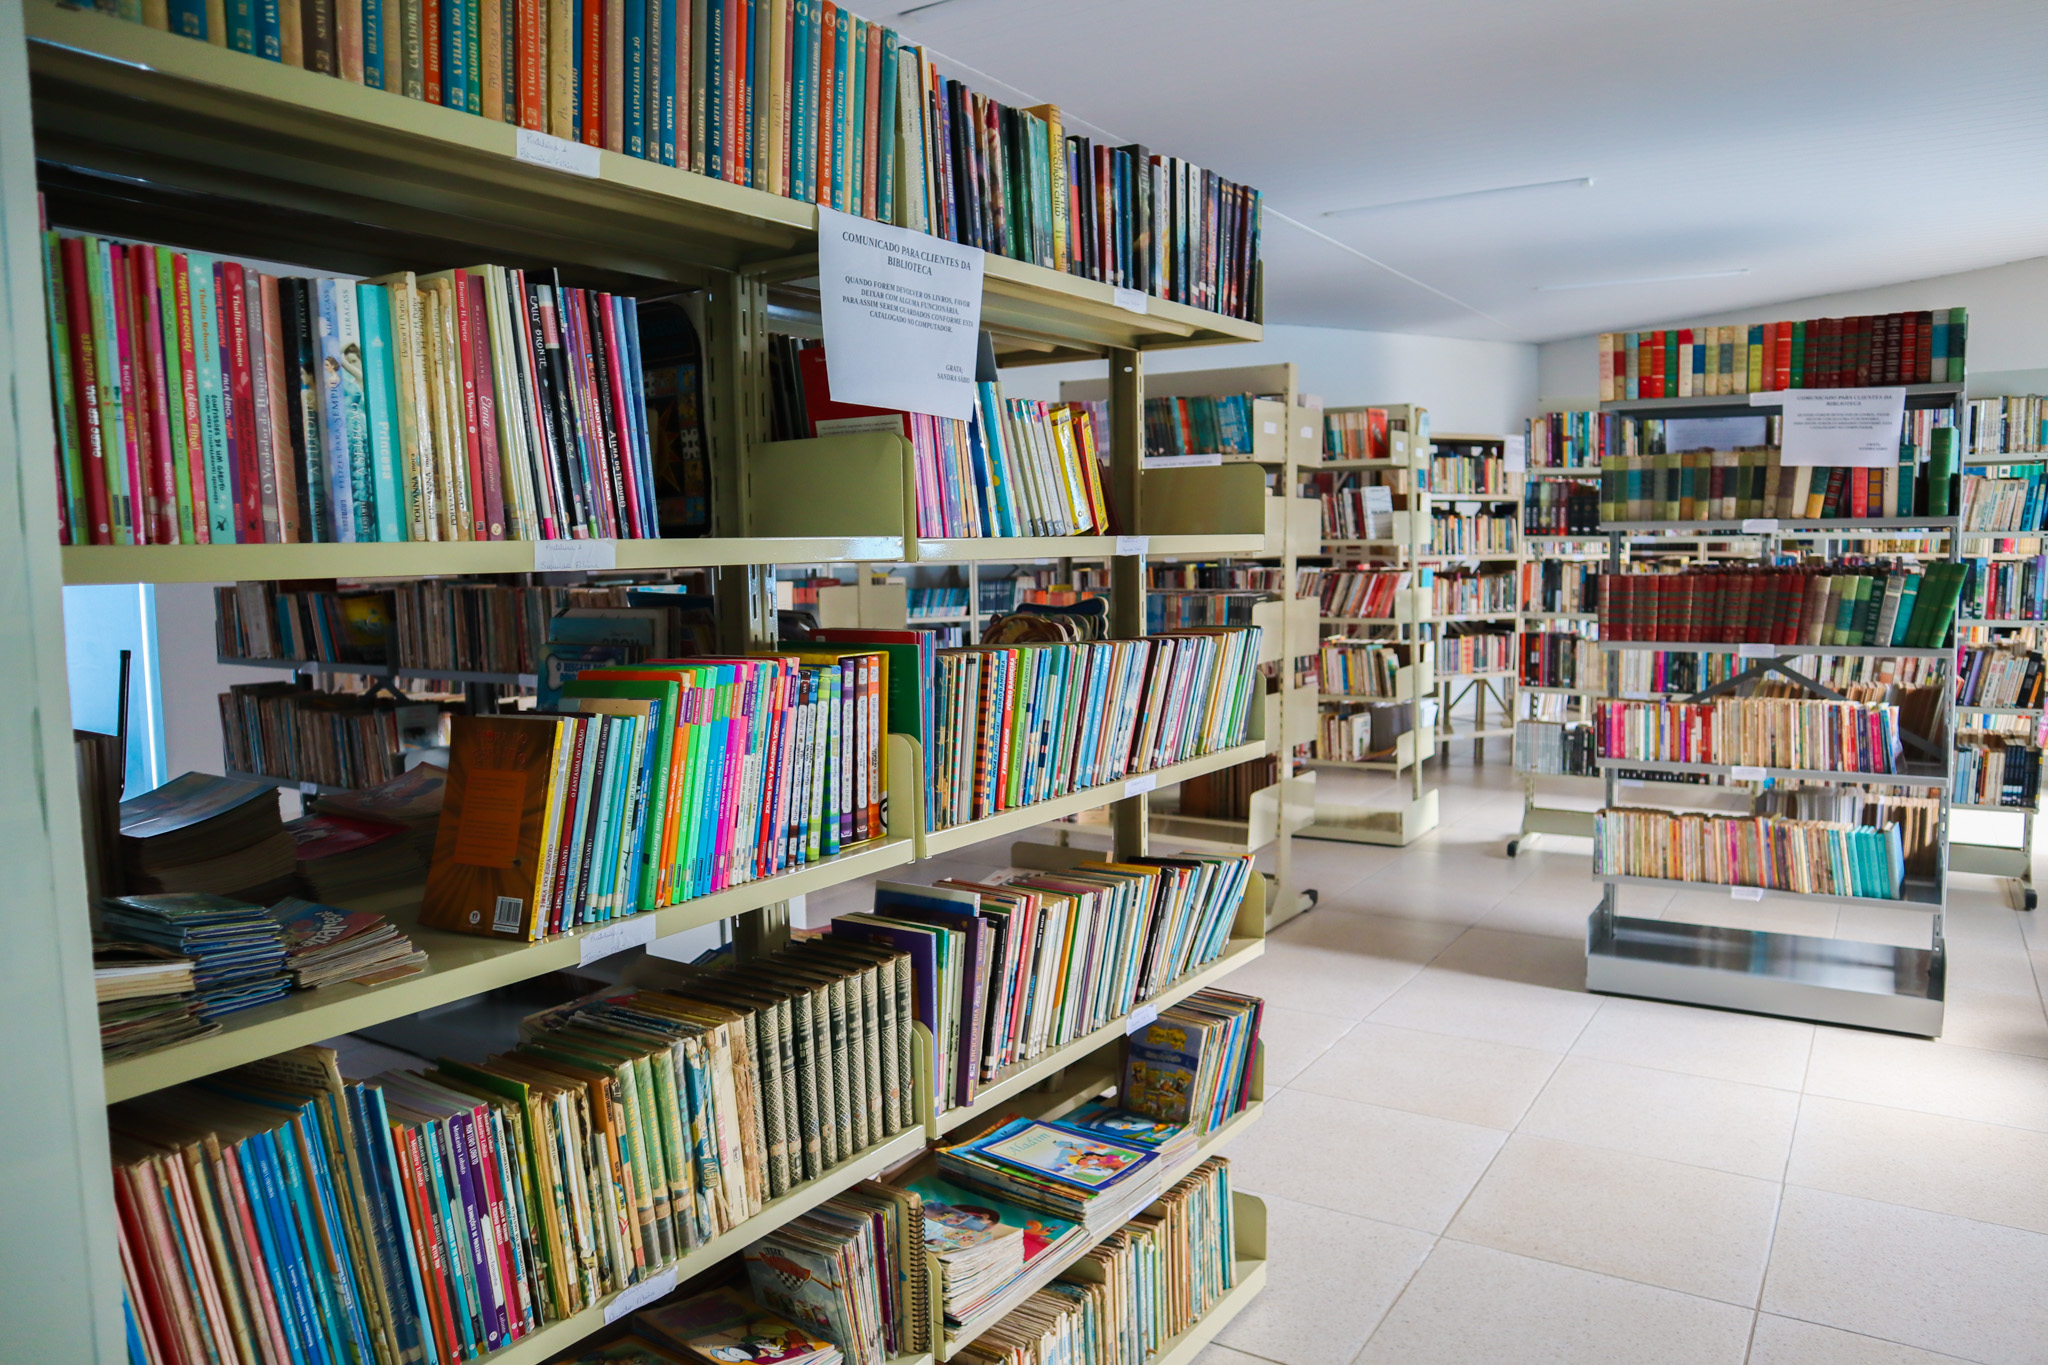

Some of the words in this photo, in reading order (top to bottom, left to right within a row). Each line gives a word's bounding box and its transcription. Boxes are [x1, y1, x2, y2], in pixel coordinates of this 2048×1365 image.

[452, 9, 461, 26] DO
[429, 13, 438, 72] ROBINSON
[453, 31, 462, 65] FILHA
[527, 42, 535, 58] AO
[591, 14, 600, 60] GULLIVER
[591, 62, 599, 75] DE
[632, 51, 640, 63] DE
[528, 59, 536, 96] VIAGEM
[591, 78, 600, 117] VIAGENS
[632, 66, 640, 118] RAPAZIADA
[825, 88, 831, 98] DO
[697, 114, 705, 141] MOBY
[837, 122, 843, 132] DE
[824, 168, 830, 178] OS
[842, 232, 900, 252] COMUNICADO
[902, 246, 919, 258] PARA
[921, 252, 959, 268] CLIENTES
[961, 260, 971, 270] DA
[888, 256, 932, 276] BIBLIOTECA
[180, 272, 189, 307] THALITA
[297, 289, 305, 309] CASS
[342, 289, 350, 309] CASS
[845, 276, 872, 287] QUANDO
[874, 281, 895, 291] FOREM
[896, 285, 922, 298] DEVOLVER
[954, 298, 970, 307] FAVOR
[861, 289, 884, 298] DEIXAR
[885, 293, 898, 301] COM
[899, 296, 919, 307] ALGUMA
[199, 289, 208, 319] Thalita
[233, 294, 243, 326] Thalita
[529, 295, 540, 322] EMILY
[843, 296, 858, 304] PARA
[859, 299, 878, 308] ASSIM
[880, 303, 898, 312] SEREM
[899, 306, 930, 319] GUARDADOS
[932, 312, 961, 324] CONFORME
[870, 311, 906, 323] CATALOGADO
[299, 311, 307, 337] KIERA
[344, 310, 352, 336] KIERA
[460, 320, 468, 342] Porter
[200, 321, 211, 363] Rebouças
[234, 329, 244, 367] Rebouças
[82, 333, 94, 383] YOUTUBER
[186, 369, 194, 390] FALA
[257, 361, 269, 408] Histórias
[937, 373, 956, 381] SANDRA
[330, 379, 341, 424] SEMPRE
[480, 395, 492, 428] Elena
[89, 408, 99, 425] SER
[211, 395, 222, 437] CONFISSÕES
[260, 412, 269, 425] de
[92, 428, 101, 458] QUERO
[214, 439, 222, 448] DE
[261, 426, 271, 479] Vendedor
[334, 428, 342, 451] PARA
[379, 421, 392, 479] Princesa
[610, 440, 619, 459] ILHA
[215, 450, 223, 463] UM
[614, 461, 621, 471] DO
[217, 466, 225, 491] GAROTO
[335, 454, 345, 489] FELIZES
[412, 476, 422, 522] POLLYANNA
[199, 502, 207, 532] ROCCO
[576, 729, 585, 748] PORÃO
[576, 750, 582, 758] DO
[571, 760, 581, 791] FANTASMA
[659, 775, 667, 799] diário
[658, 800, 665, 810] de
[654, 811, 663, 829] Gian
[560, 845, 569, 876] ESPANTO
[651, 831, 661, 868] Burrasca
[626, 1096, 635, 1127] BENTA
[452, 1124, 463, 1151] Monteiro
[458, 1153, 467, 1174] Lobato
[631, 1129, 640, 1157] DONA
[1006, 1132, 1051, 1155] Aladim
[410, 1139, 420, 1165] Monteiro
[415, 1167, 424, 1187] Lobato
